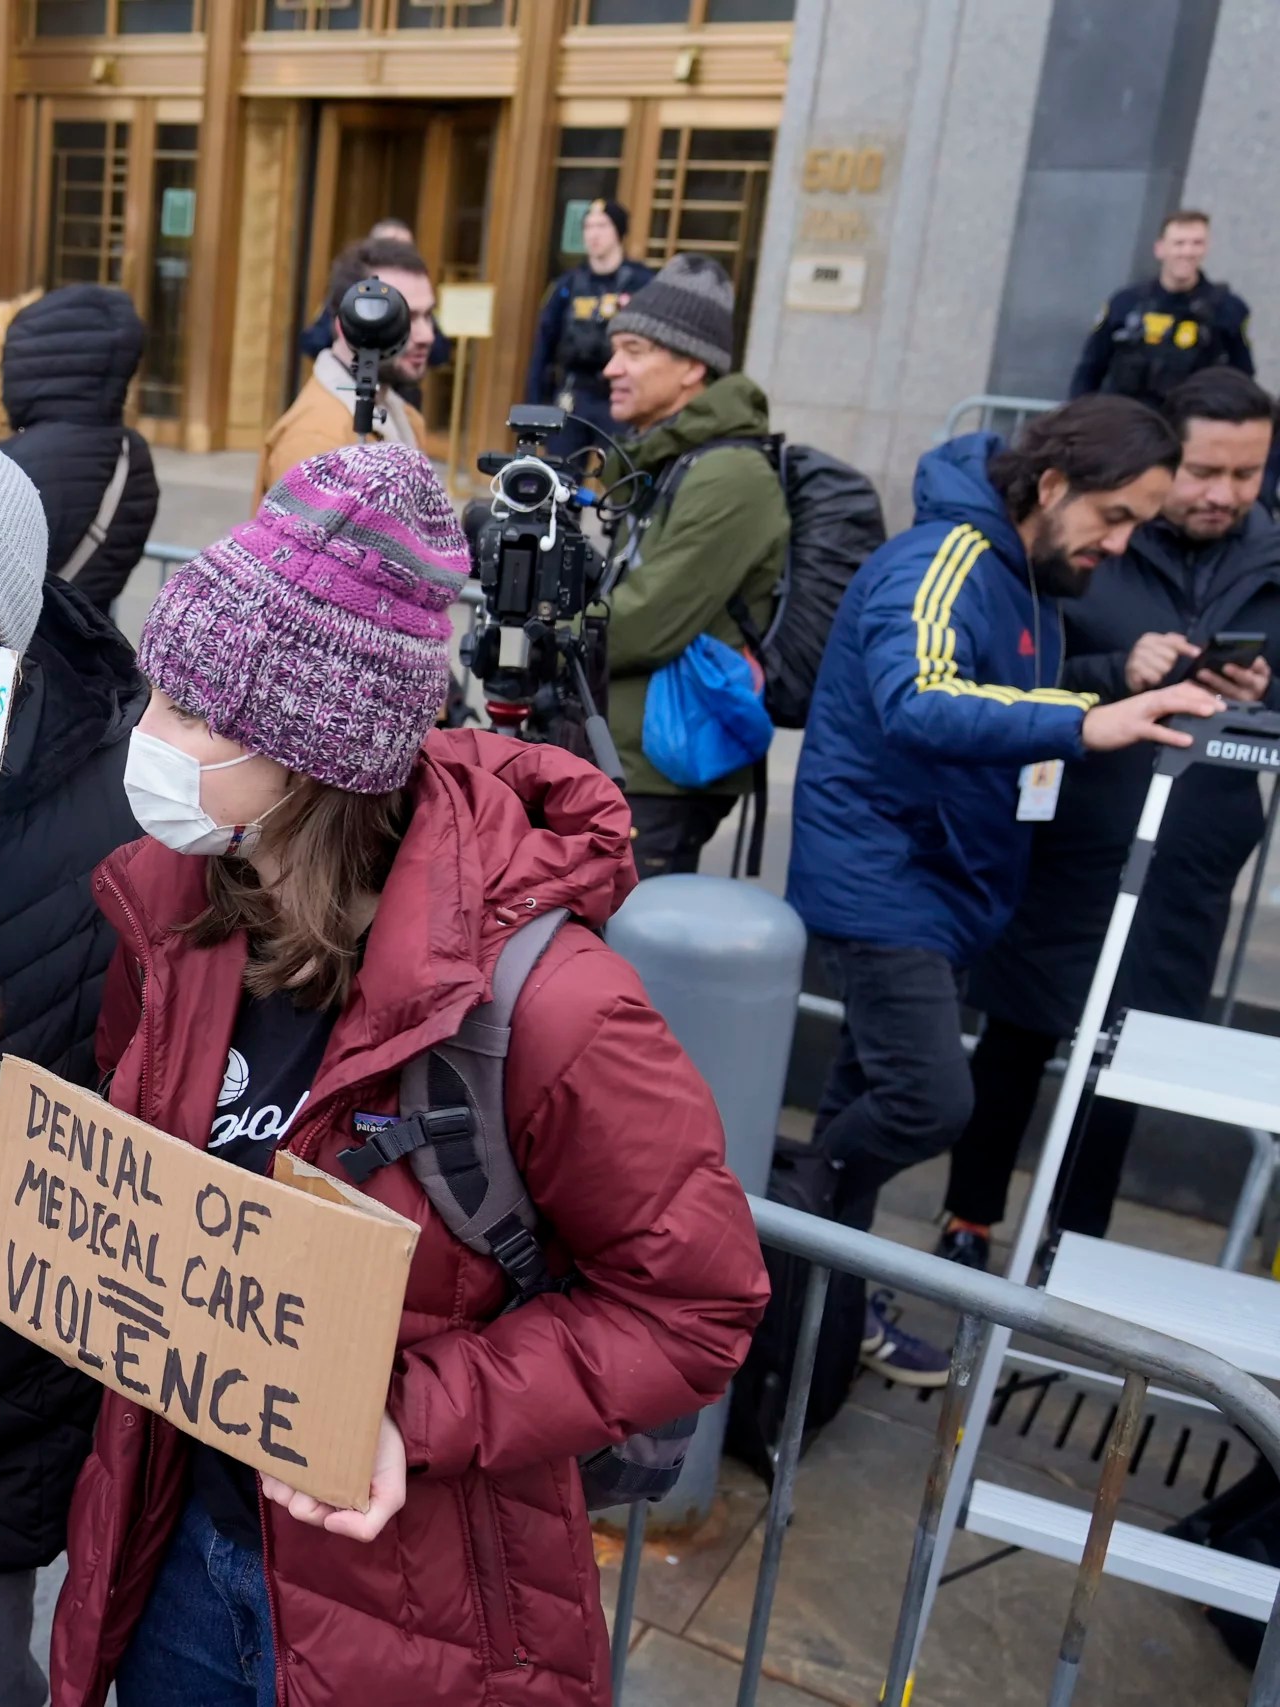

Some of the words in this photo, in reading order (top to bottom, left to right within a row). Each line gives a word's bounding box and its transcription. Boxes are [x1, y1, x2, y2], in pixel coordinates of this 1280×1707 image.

[14, 1160, 167, 1288] MEDICAL
[181, 1255, 305, 1350] CARE
[26, 1083, 163, 1206] DENIAL
[195, 1183, 272, 1255] OF
[7, 1239, 308, 1468] VIOLENCE
